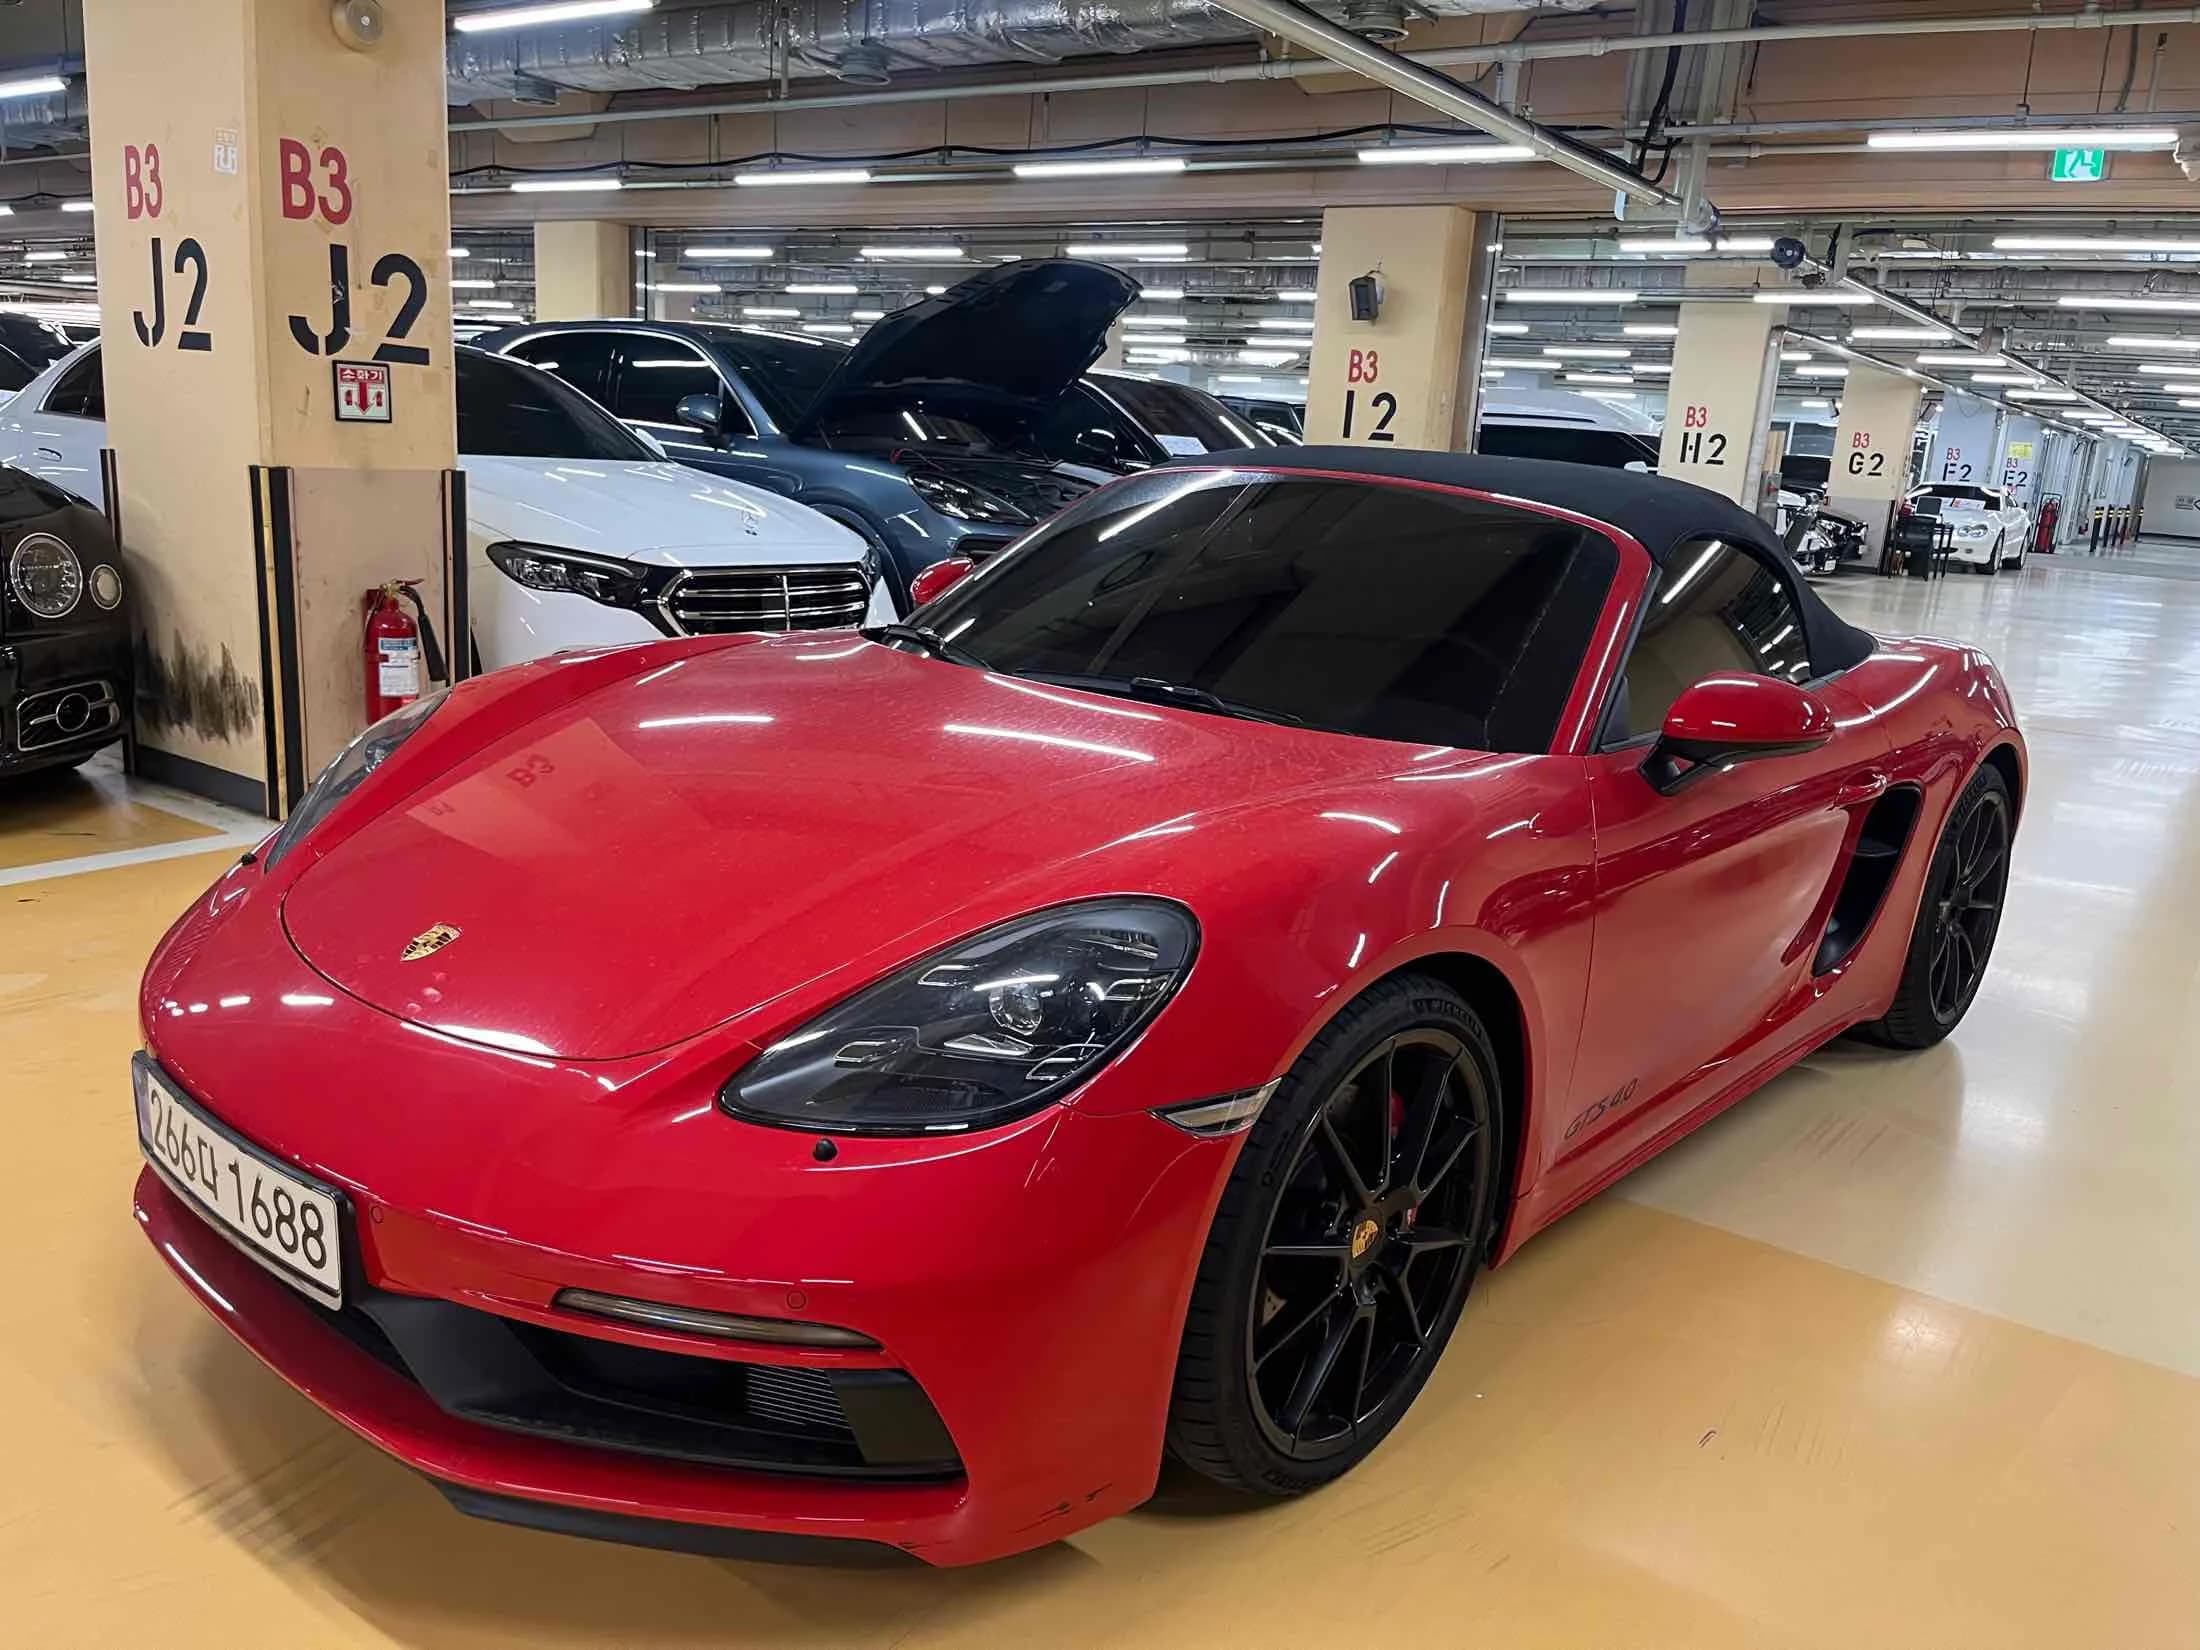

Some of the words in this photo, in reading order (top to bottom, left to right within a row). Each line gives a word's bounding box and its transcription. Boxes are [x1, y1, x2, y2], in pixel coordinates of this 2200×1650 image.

[124, 143, 163, 219] B3
[279, 138, 352, 225] B3
[132, 237, 212, 352] J2
[287, 243, 430, 366] J2
[342, 369, 383, 380] 소화기
[1348, 349, 1378, 383] B3
[1685, 406, 1707, 428] B3
[1680, 431, 1727, 465] H2
[1852, 431, 1870, 448] B3
[1946, 447, 1961, 460] B3
[1849, 451, 1884, 476] G2
[1563, 1095, 1610, 1140] GTS
